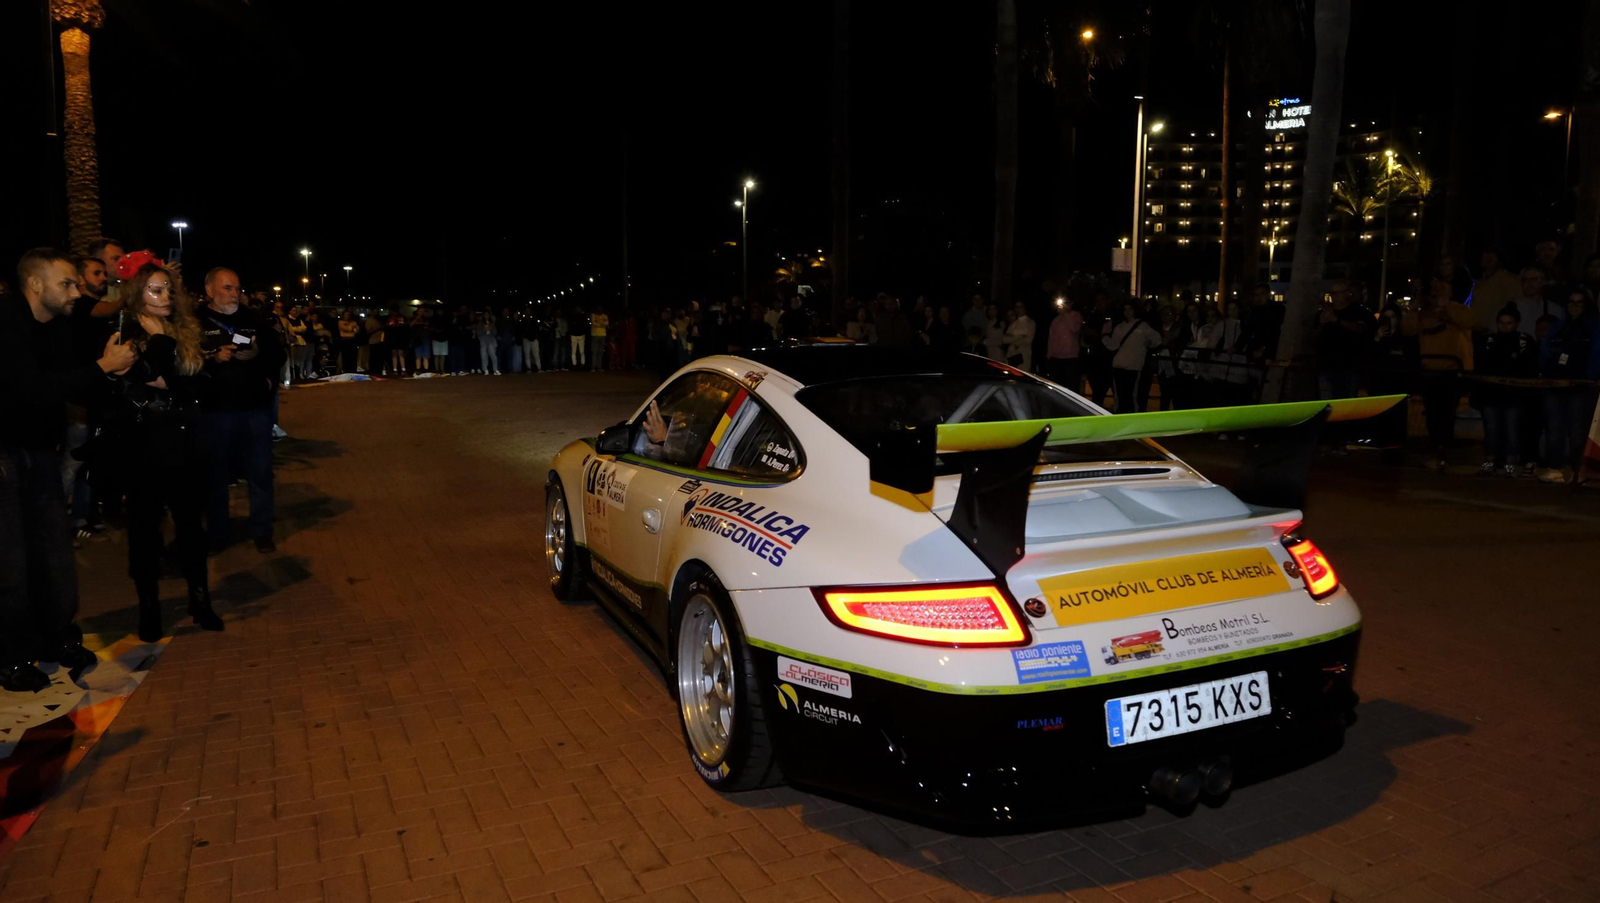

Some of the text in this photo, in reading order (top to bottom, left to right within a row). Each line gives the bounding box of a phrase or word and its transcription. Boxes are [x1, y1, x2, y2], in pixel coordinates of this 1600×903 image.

[1282, 105, 1312, 117] HOTE
[699, 491, 811, 545] INDALICA
[686, 512, 787, 567] HORMIGONES
[1059, 562, 1276, 609] AUTOMÓVIL CLUB DE ALMERÍA
[1161, 612, 1271, 640] Bombeos Motril S.L.
[1187, 634, 1218, 646] BOMBEOS
[1223, 627, 1259, 639] GUNITADOS
[1015, 644, 1083, 660] radio poniente
[803, 700, 862, 724] ALMERIA
[803, 709, 839, 725] CIRCUIT
[1126, 679, 1262, 737] 7315 KXS
[1016, 716, 1063, 730] PLEMAR
[1112, 726, 1120, 737] E
